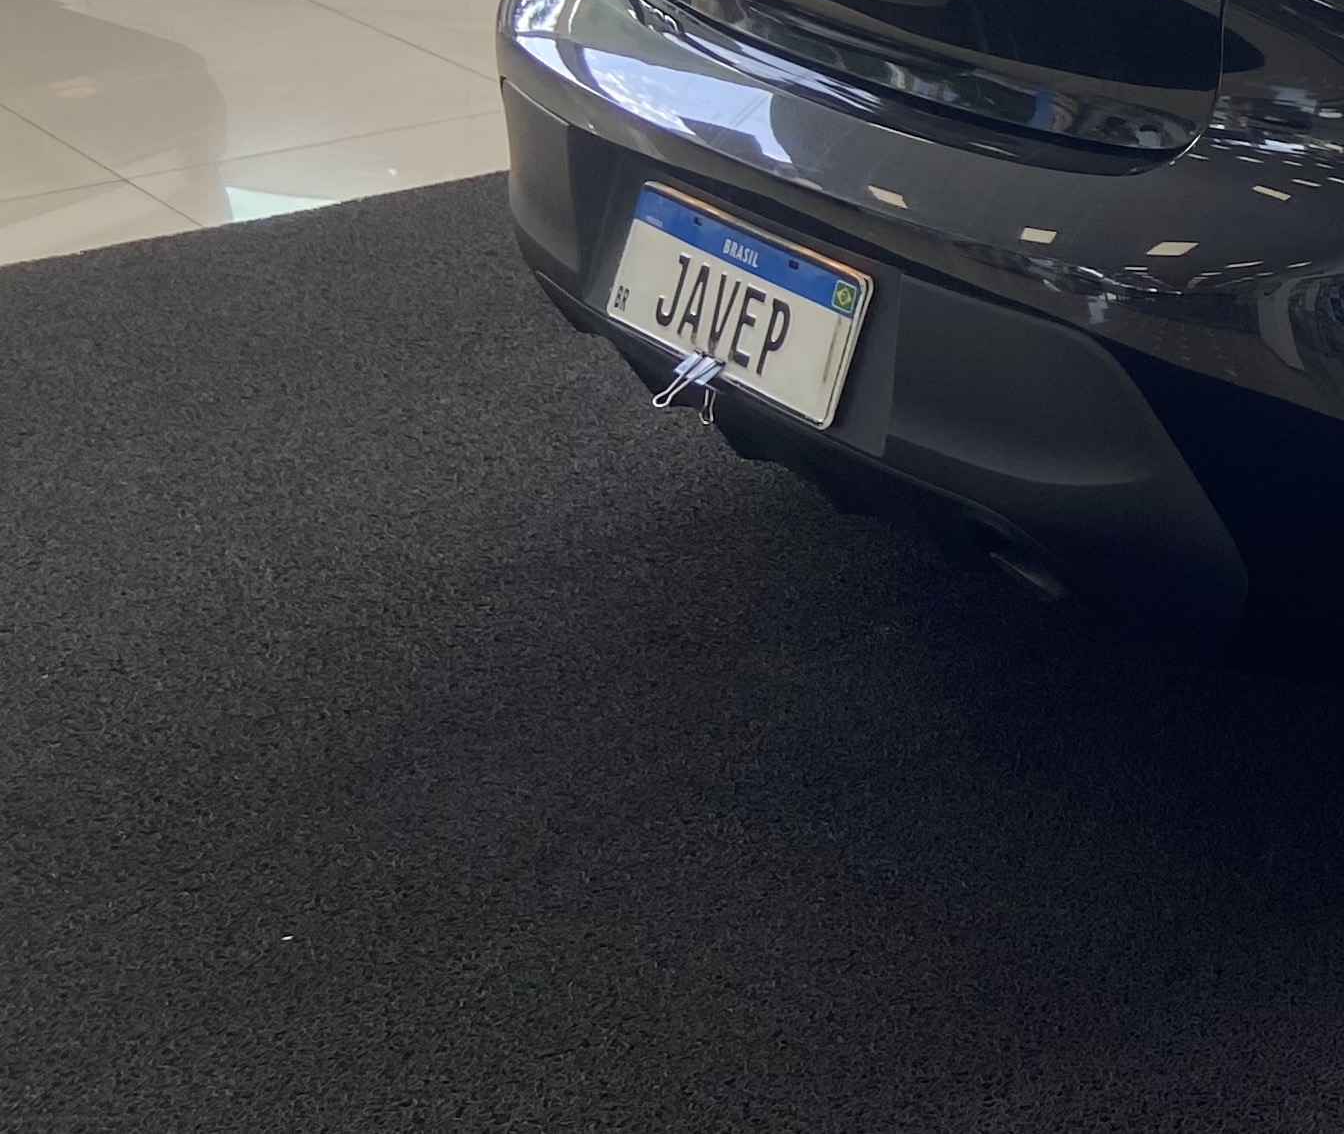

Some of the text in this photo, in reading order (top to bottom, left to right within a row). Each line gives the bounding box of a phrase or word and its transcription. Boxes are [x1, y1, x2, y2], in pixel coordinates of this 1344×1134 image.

[722, 238, 759, 268] BRASIL
[613, 285, 630, 312] BR
[655, 252, 792, 376] JAVEP
